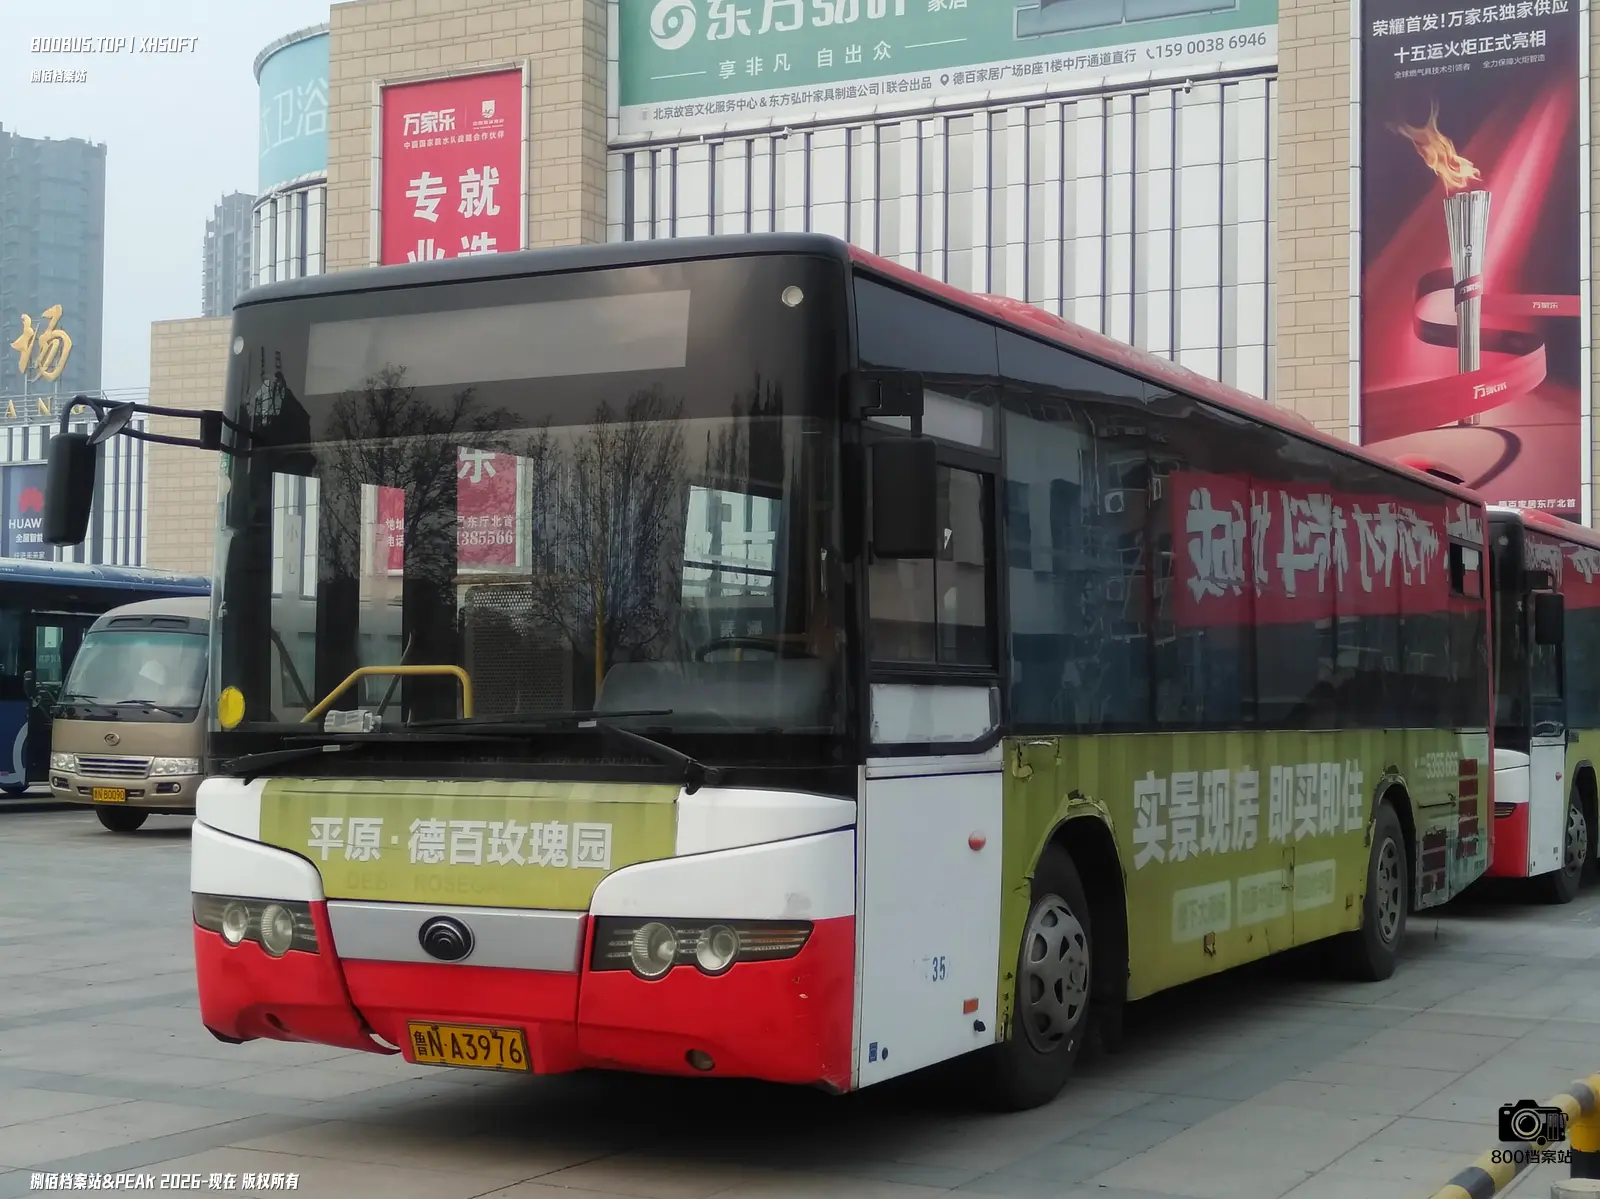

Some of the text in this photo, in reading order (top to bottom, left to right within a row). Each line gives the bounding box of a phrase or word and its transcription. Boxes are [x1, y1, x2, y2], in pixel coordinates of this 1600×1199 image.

[718, 40, 892, 79] 享非凡 自出众
[1155, 44, 1183, 59] 159
[1187, 37, 1225, 56] 0038
[1229, 32, 1267, 49] 6946
[1394, 30, 1547, 64] 十五运火炬正式亮相
[403, 108, 456, 136] 万家乐
[10, 304, 73, 382] 场
[1133, 758, 1364, 871] 实景现房 即买即住
